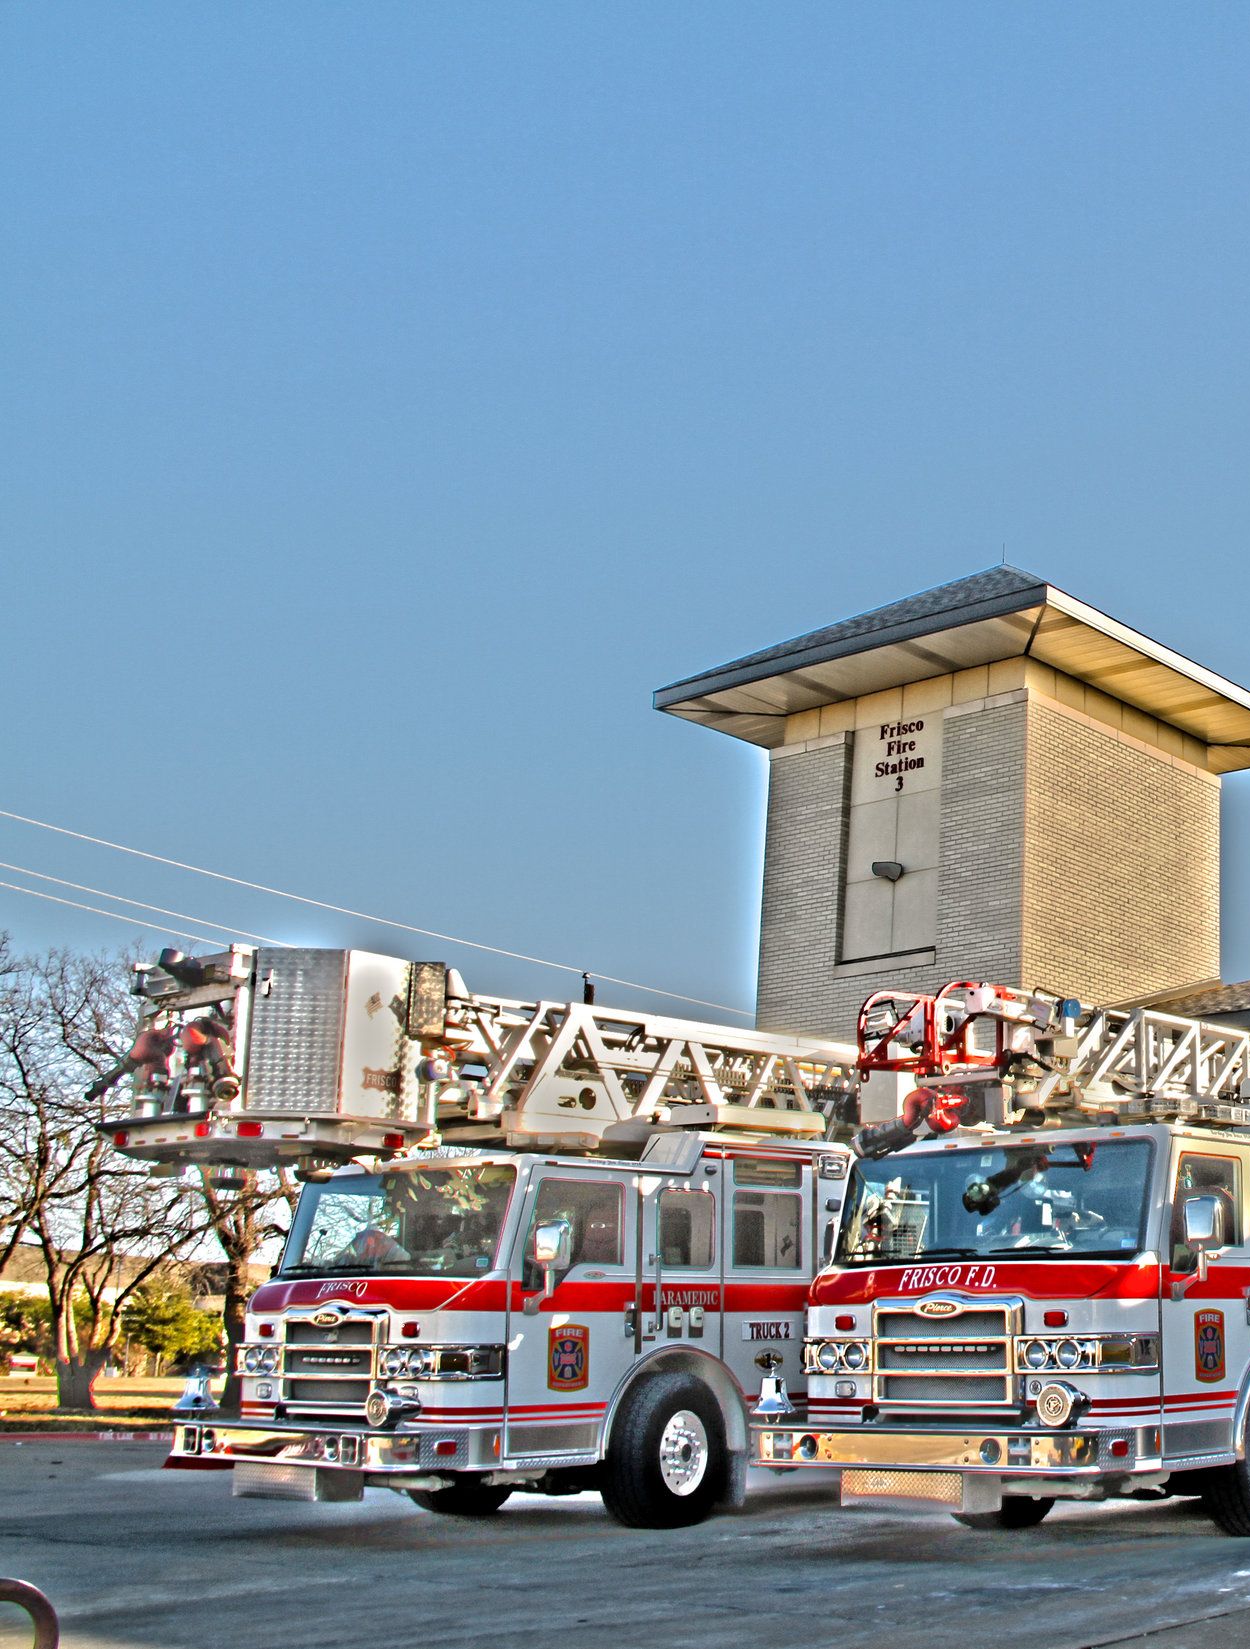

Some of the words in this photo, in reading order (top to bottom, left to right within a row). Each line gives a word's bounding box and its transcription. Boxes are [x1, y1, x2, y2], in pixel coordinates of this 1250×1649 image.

[879, 720, 924, 740] Frisco
[887, 740, 916, 757] Fire
[875, 757, 925, 778] Station
[895, 776, 904, 792] 3
[366, 1073, 397, 1087] FRISCO
[897, 1266, 962, 1291] FRISCO
[965, 1266, 997, 1288] F.D.
[315, 1281, 368, 1300] FRISCO
[924, 1302, 954, 1313] Pierce
[1199, 1313, 1221, 1324] FIRE
[555, 1328, 584, 1337] FIRE
[749, 1322, 783, 1339] TRUCK
[783, 1322, 790, 1338] 2
